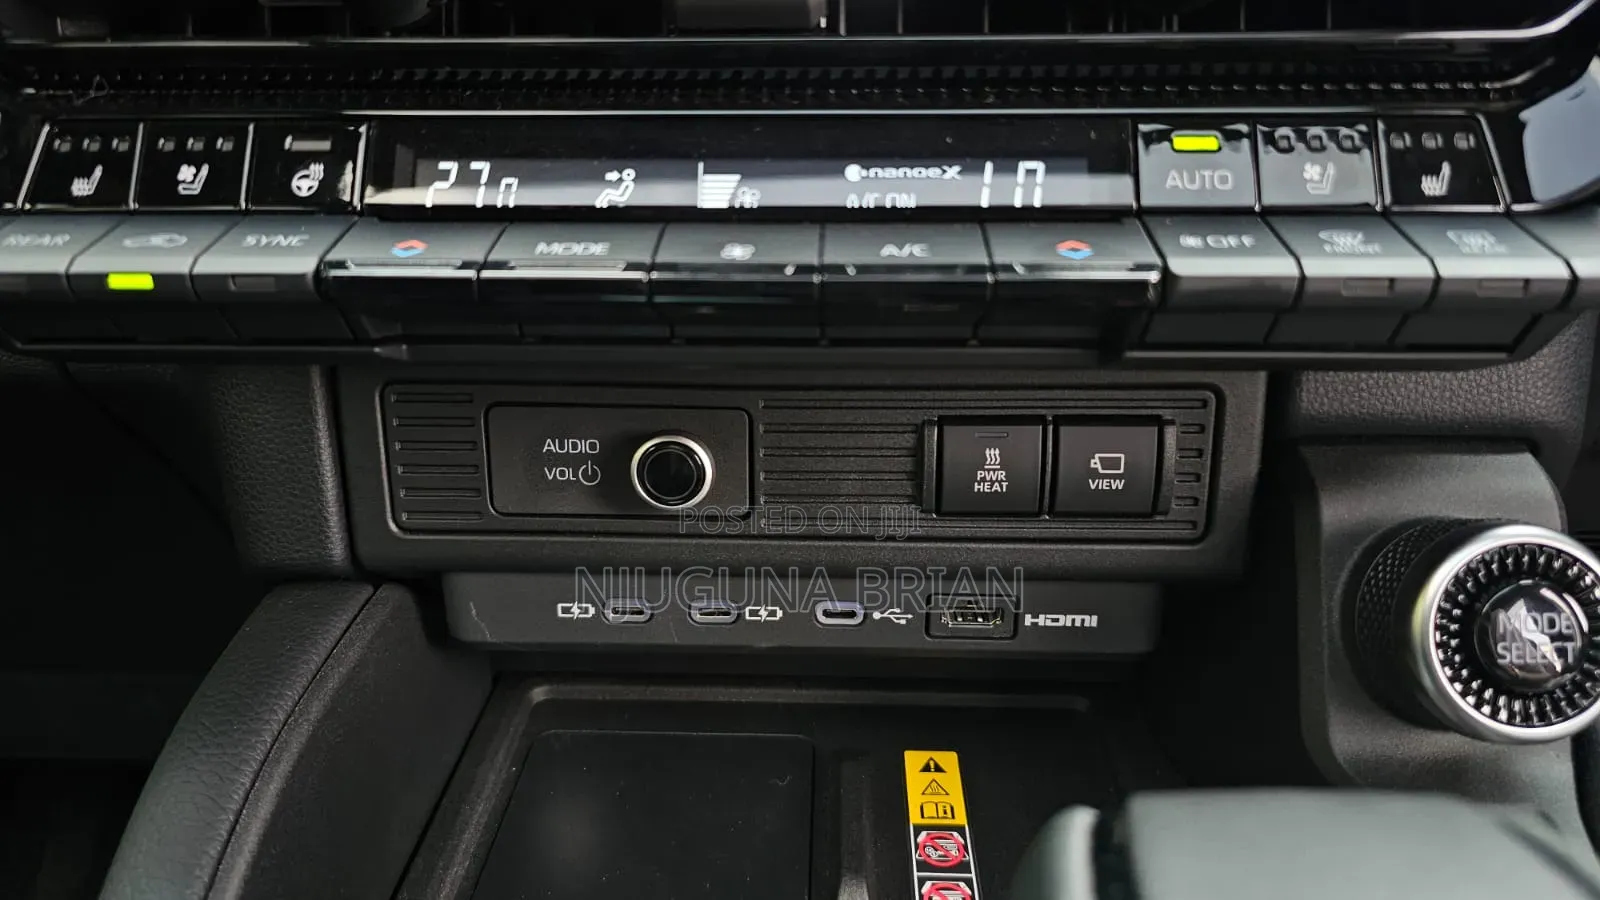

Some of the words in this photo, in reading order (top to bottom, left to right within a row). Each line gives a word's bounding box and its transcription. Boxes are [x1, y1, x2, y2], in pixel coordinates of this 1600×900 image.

[1165, 168, 1235, 191] AUTO
[241, 234, 311, 248] SYNC
[534, 241, 612, 256] MODE
[1206, 234, 1257, 249] OFF
[879, 242, 932, 257] A/C
[542, 438, 600, 454] AUDIO
[544, 466, 577, 481] VOL
[976, 470, 1007, 481] PWR
[973, 481, 1009, 493] HEAT
[1088, 478, 1125, 490] VIEW
[1024, 613, 1099, 628] HDMI
[1497, 610, 1574, 633] MODE
[1496, 641, 1576, 664] SELECT
